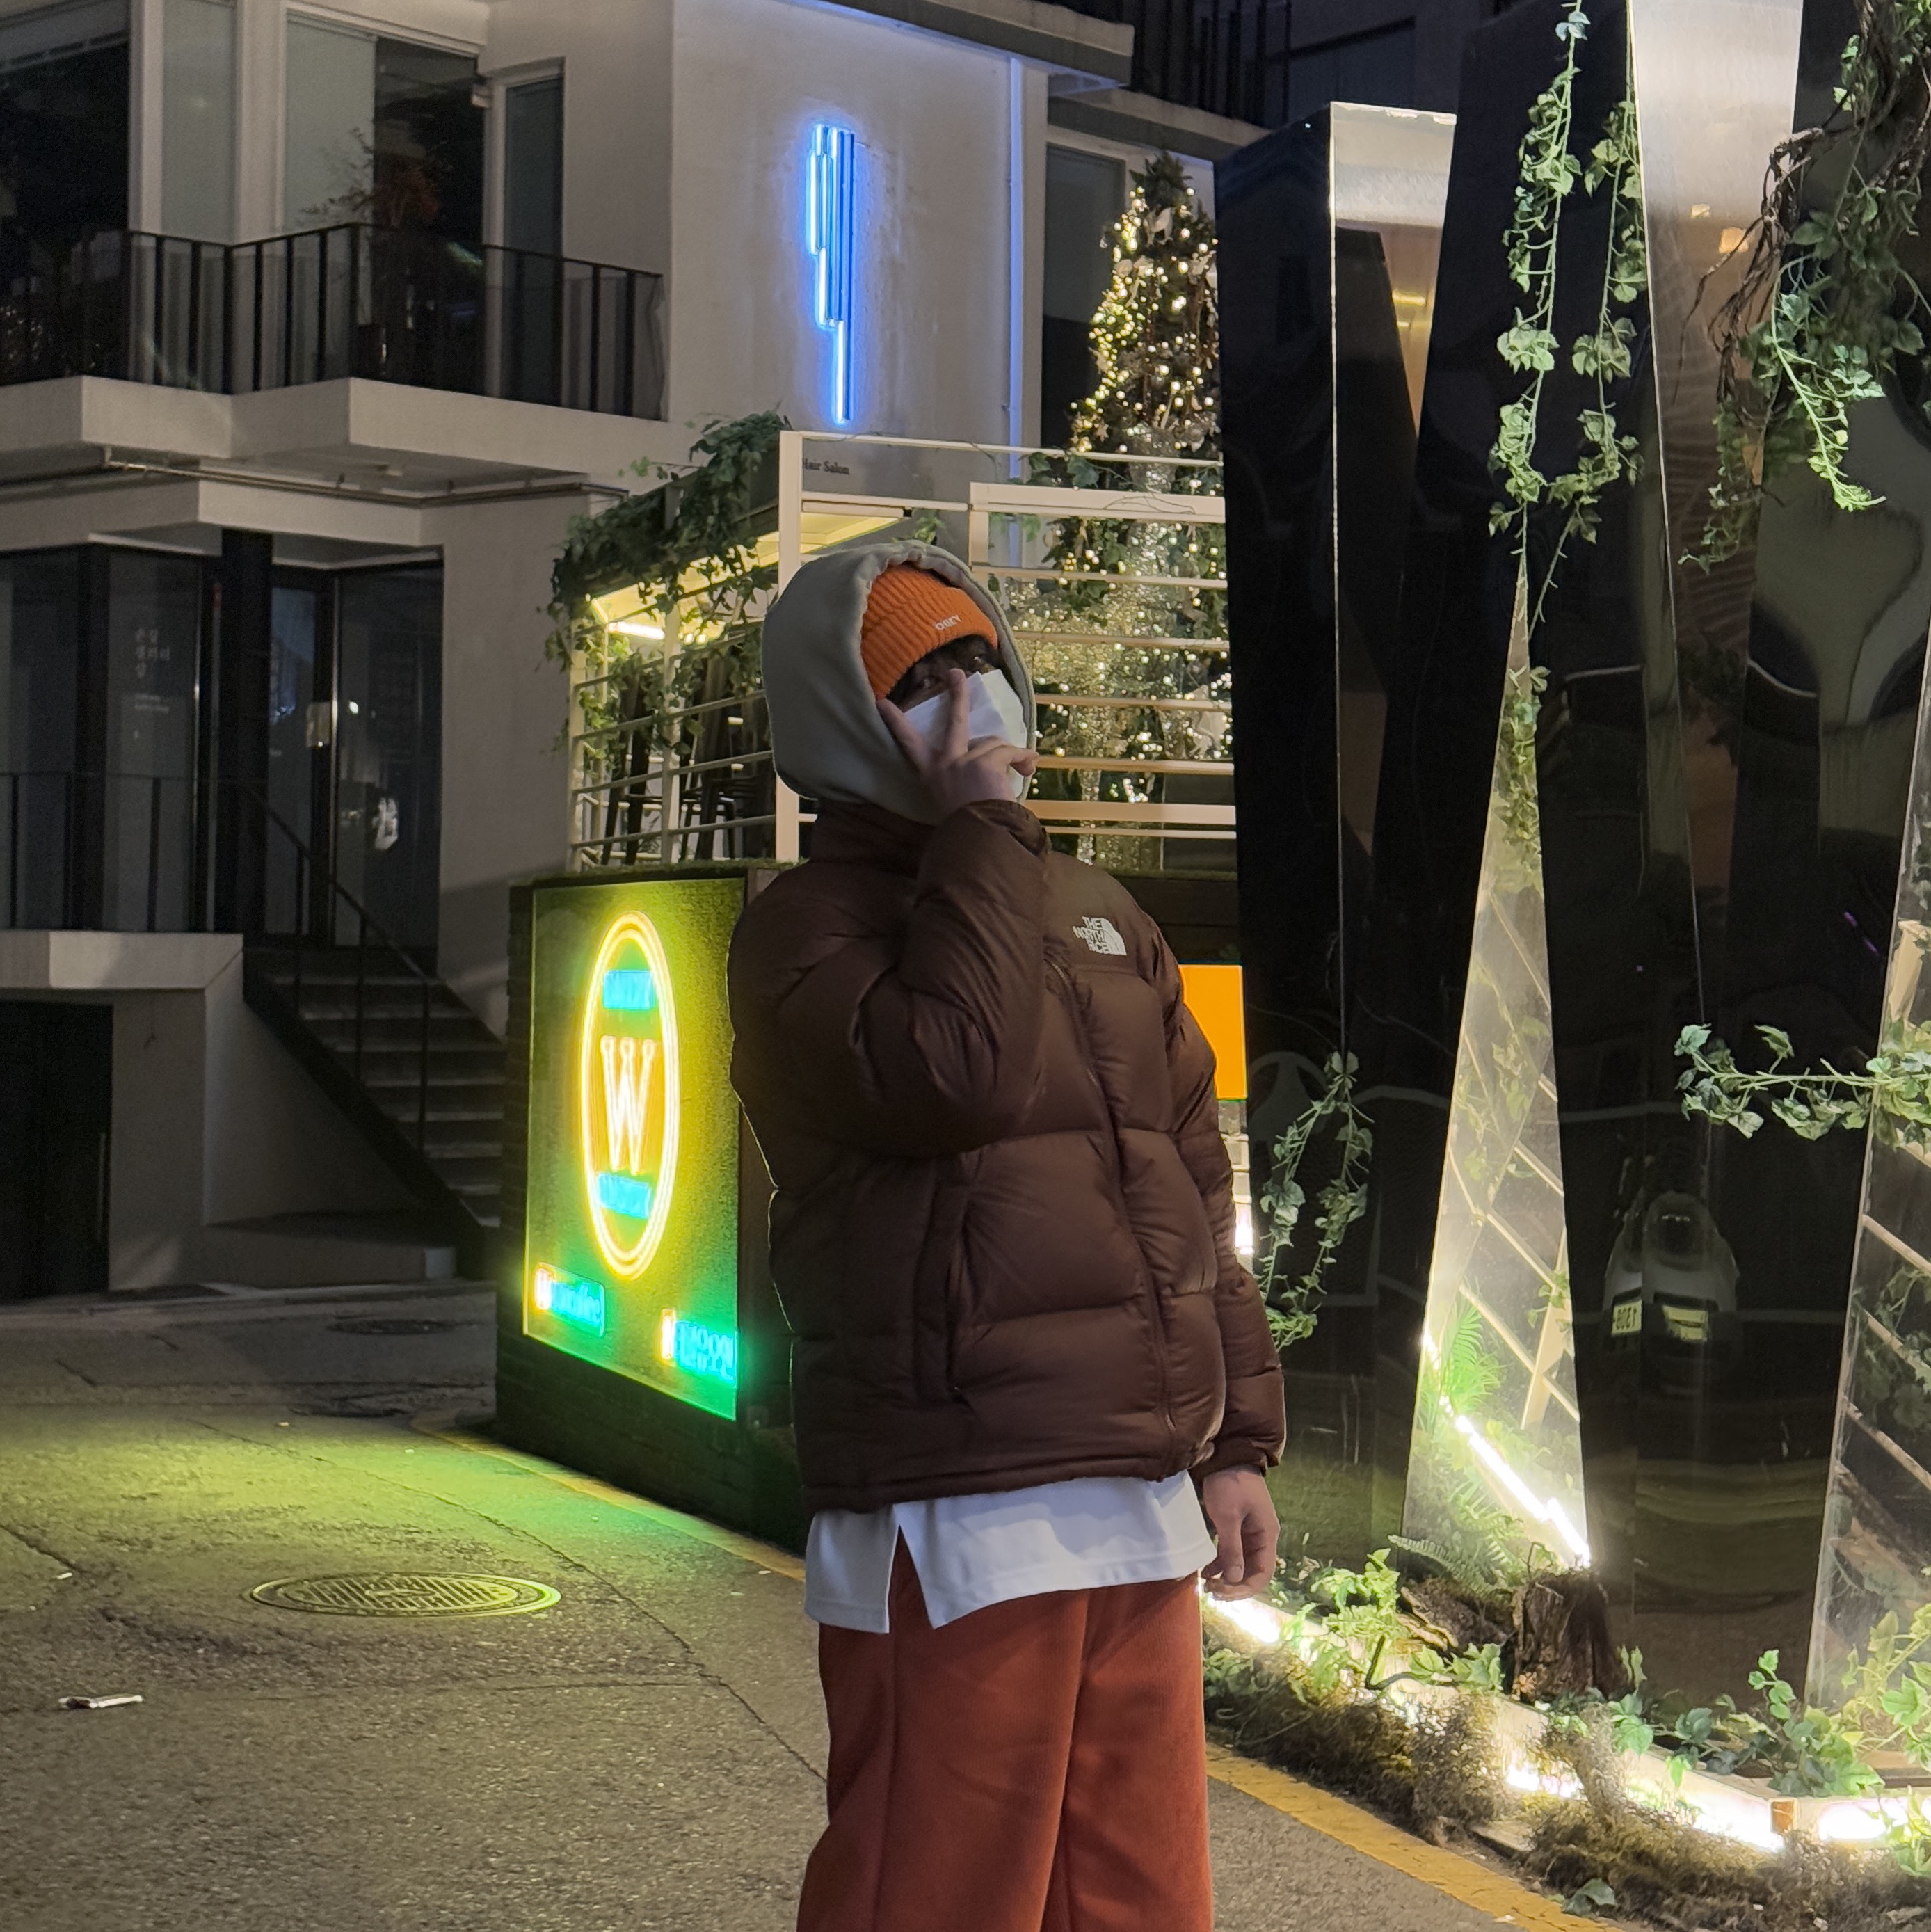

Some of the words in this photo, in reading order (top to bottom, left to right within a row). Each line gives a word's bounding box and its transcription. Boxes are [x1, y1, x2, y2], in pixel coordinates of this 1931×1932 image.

[823, 461, 850, 475] Salon
[1082, 916, 1103, 929] THE
[1072, 926, 1105, 942] NORTH
[600, 1035, 655, 1176] W
